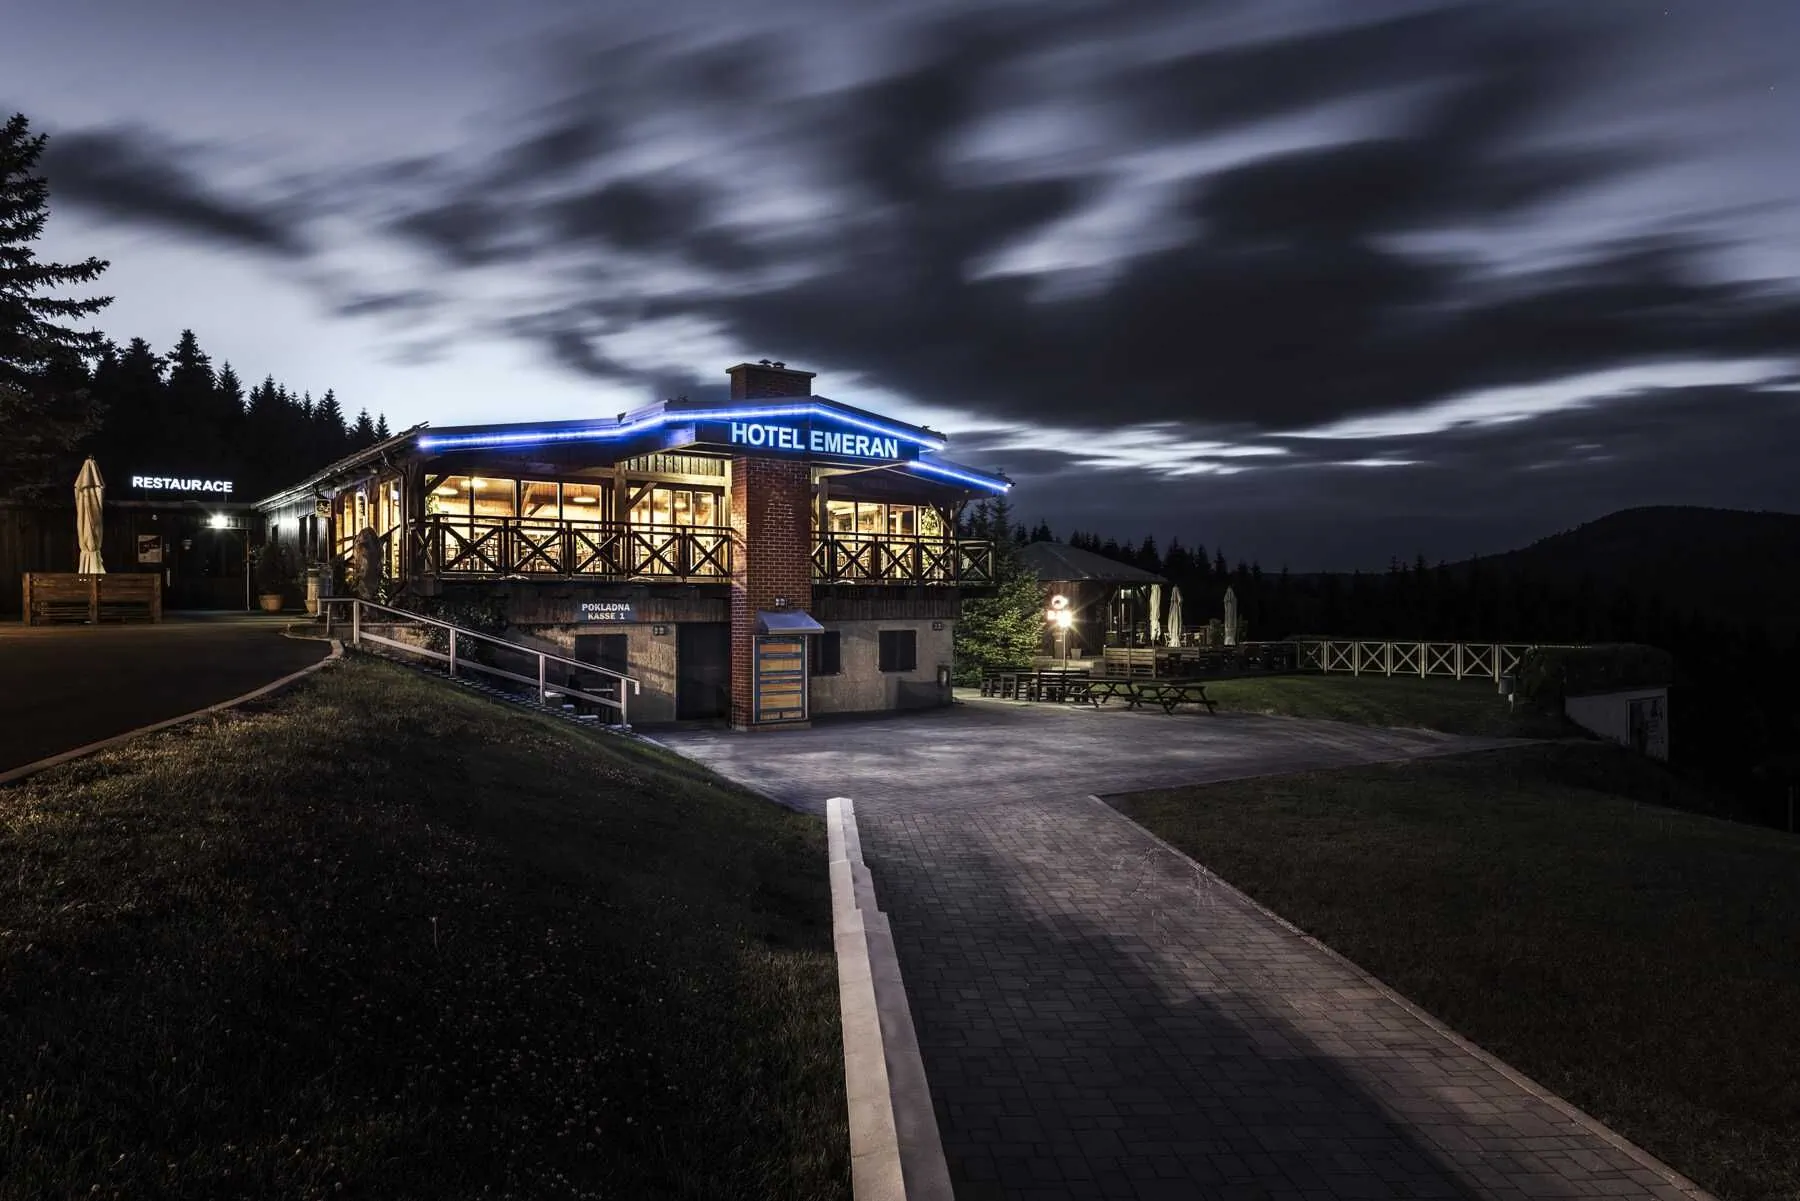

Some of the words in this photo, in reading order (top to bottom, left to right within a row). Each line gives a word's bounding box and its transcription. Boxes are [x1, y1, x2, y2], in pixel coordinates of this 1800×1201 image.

[731, 422, 805, 450] HOTEL
[810, 431, 898, 459] EMERAN
[132, 476, 233, 492] RESTAURACE
[582, 603, 630, 611] POKLADNA
